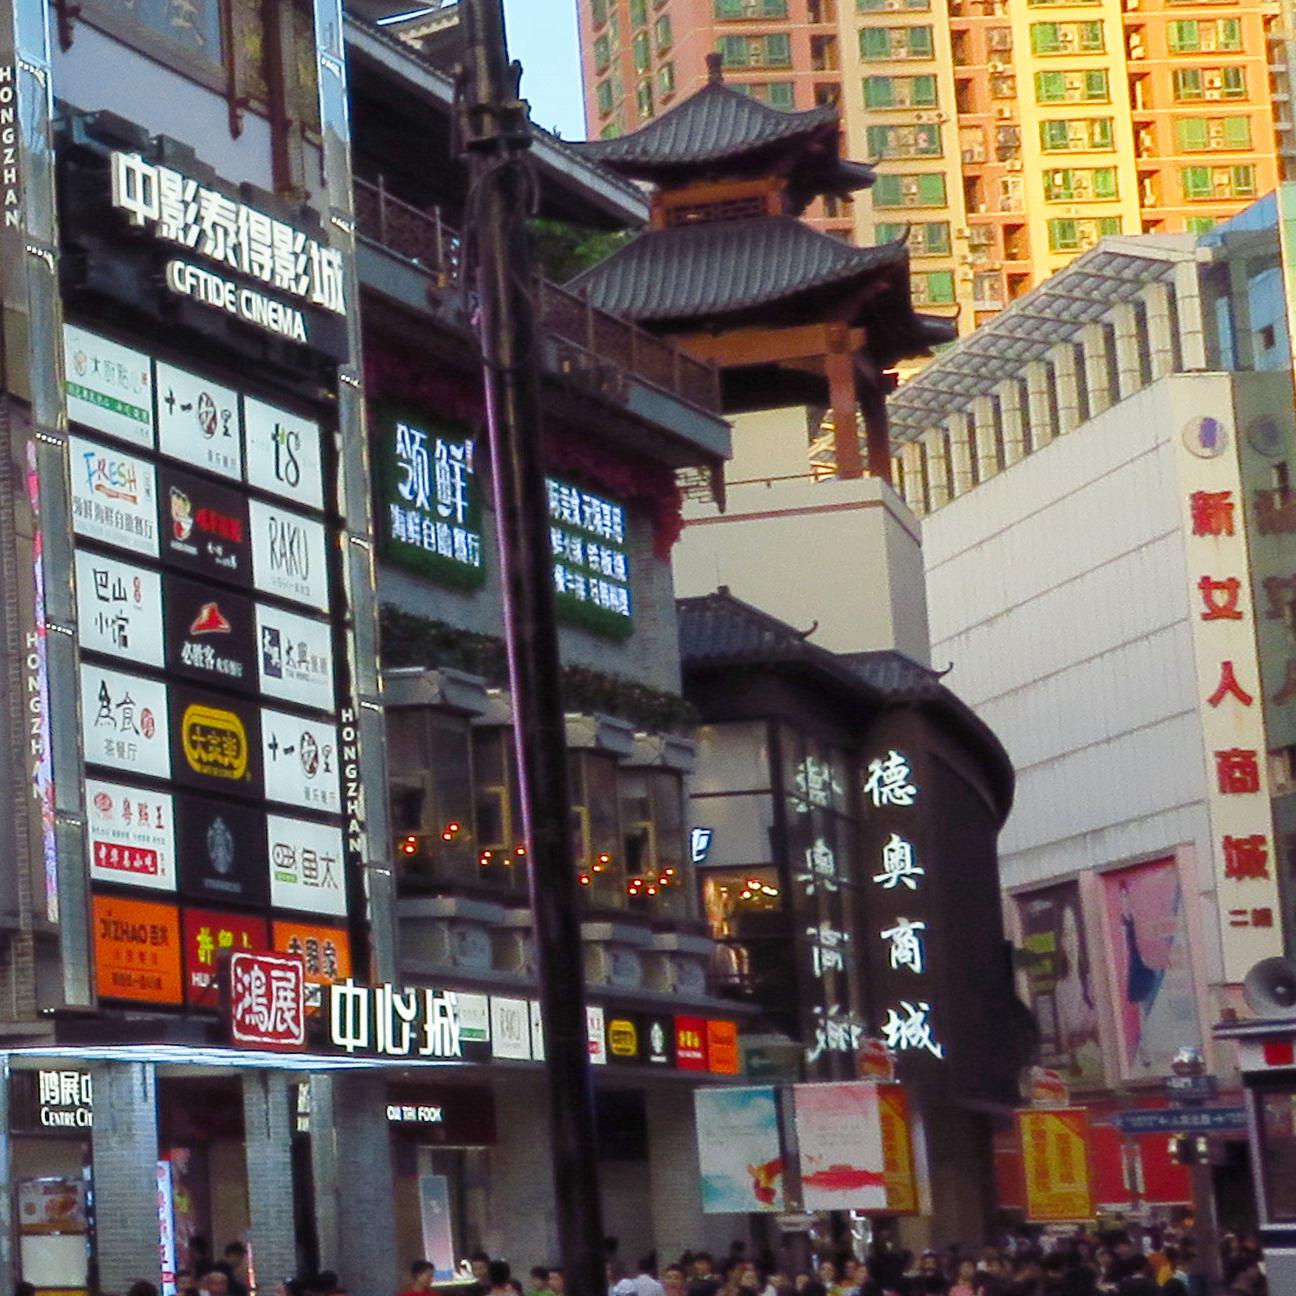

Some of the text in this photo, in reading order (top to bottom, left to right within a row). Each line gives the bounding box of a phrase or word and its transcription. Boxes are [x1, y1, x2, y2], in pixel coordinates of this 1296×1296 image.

[110, 150, 346, 317] 中影泰得影城
[241, 284, 307, 343] CINEMA
[82, 450, 138, 495] FRESH
[396, 422, 469, 525] 领鲜
[268, 515, 310, 580] RAKU
[1190, 490, 1271, 884] 新女人商城
[341, 707, 363, 853] HONGZHAN
[864, 749, 945, 1060] 德奥商城
[236, 964, 462, 1058] 鴻展 中心城
